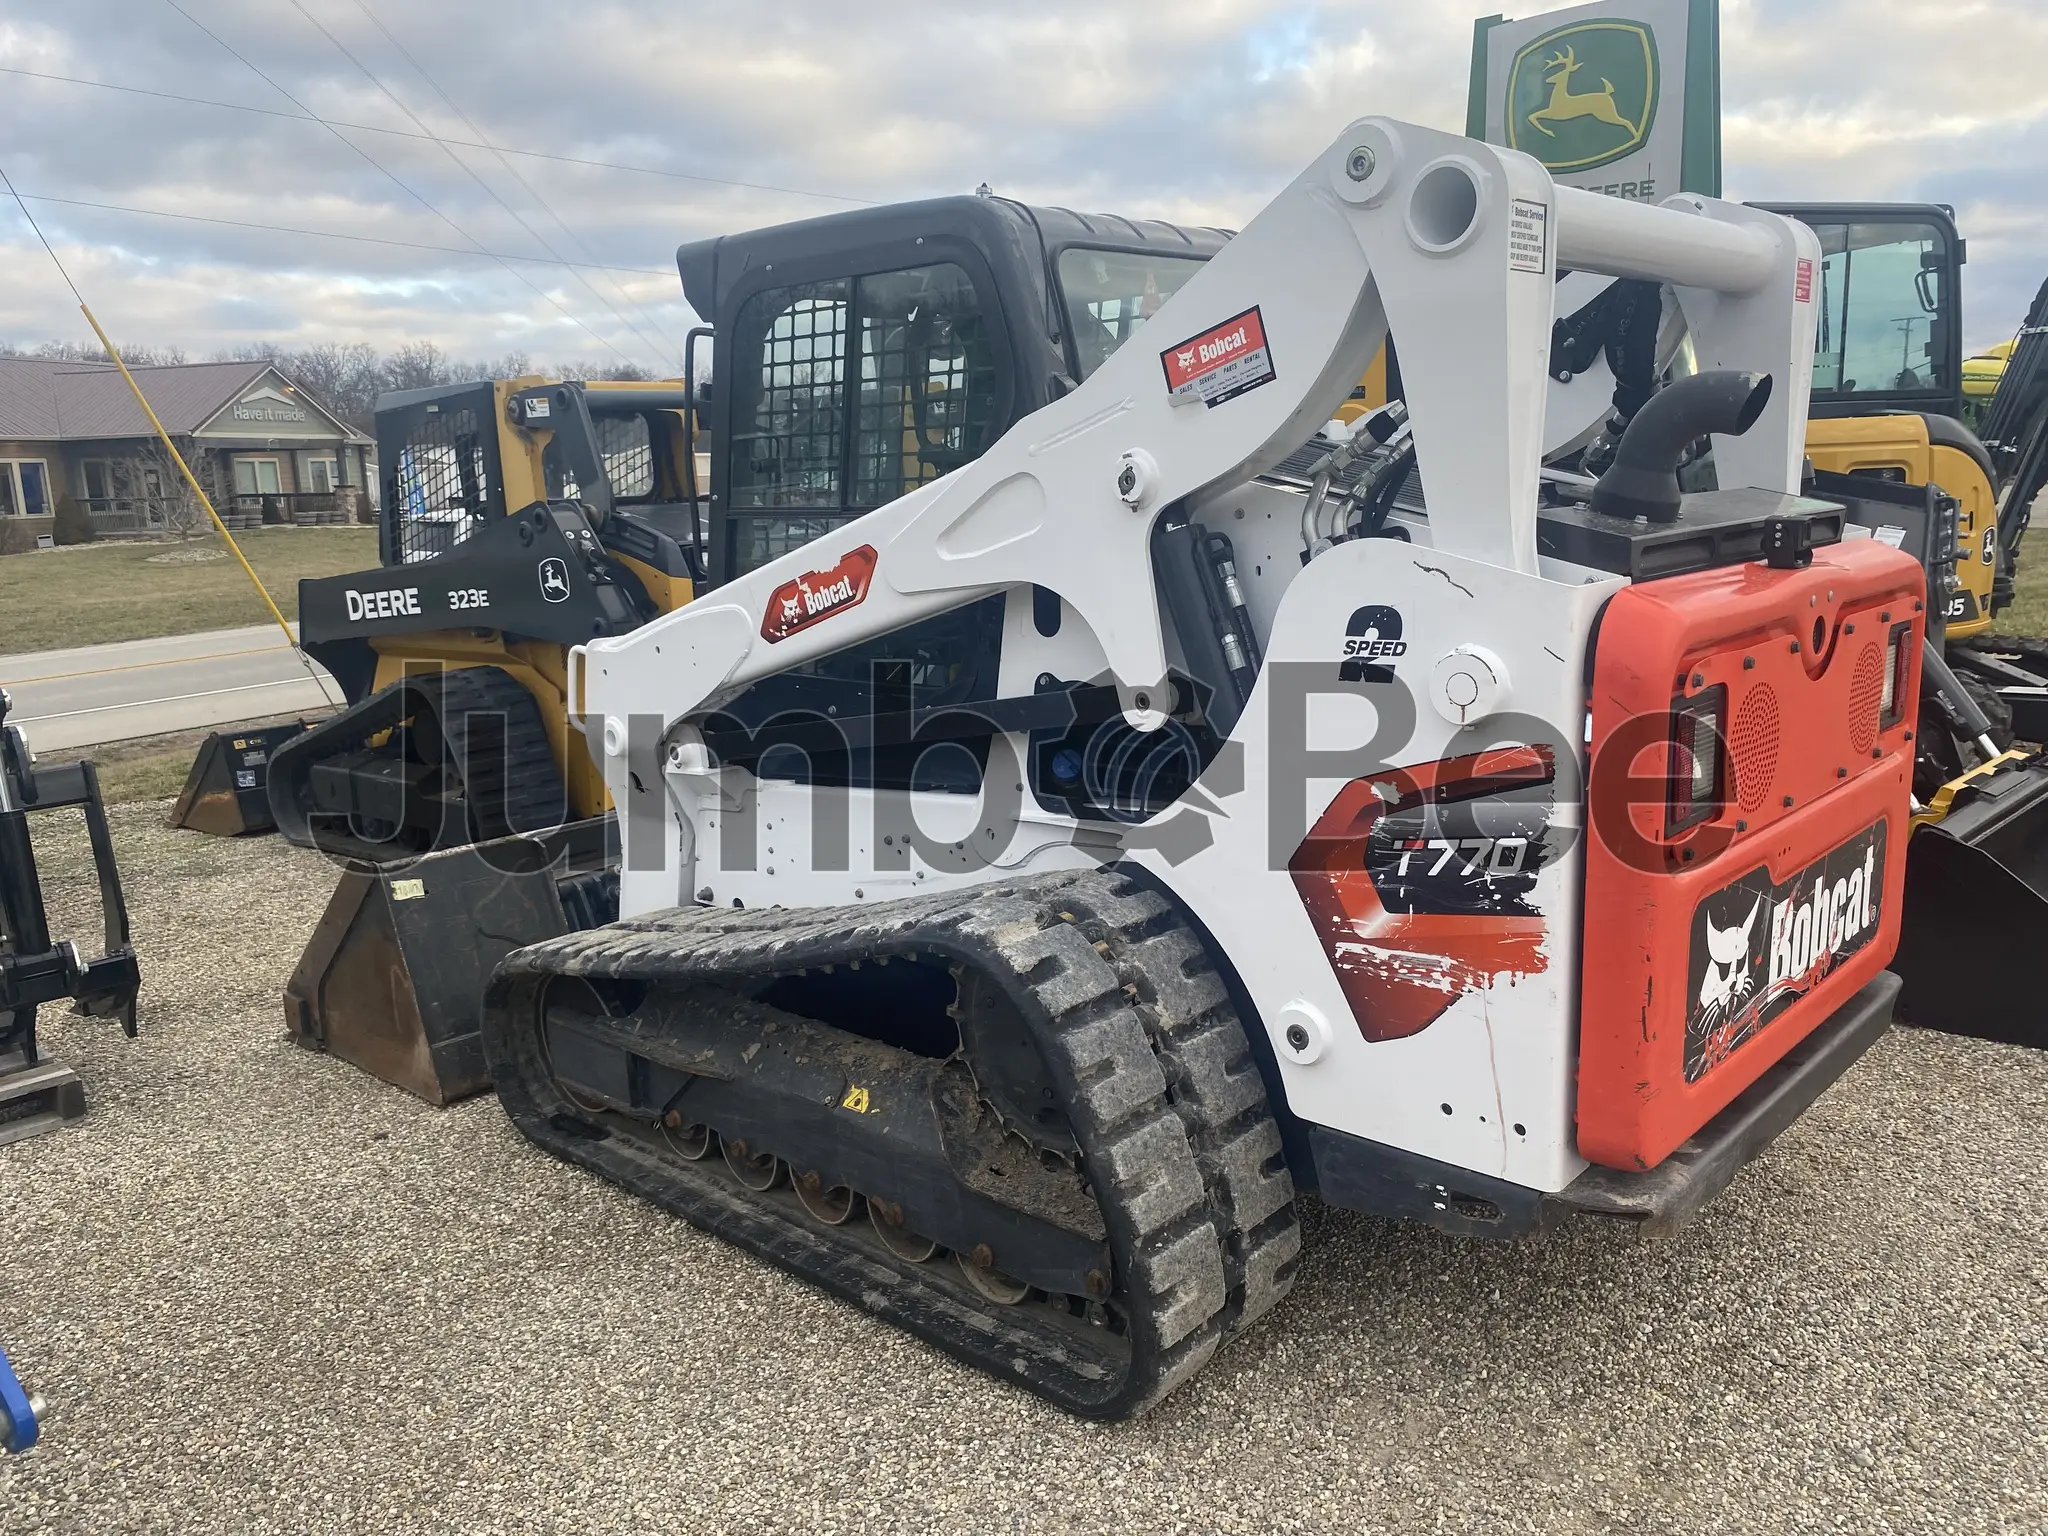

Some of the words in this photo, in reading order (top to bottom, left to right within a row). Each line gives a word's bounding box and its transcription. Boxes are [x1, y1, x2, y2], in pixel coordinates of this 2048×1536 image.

[1569, 179, 1655, 200] ERE
[1514, 206, 1529, 219] Bobcat
[1529, 209, 1544, 221] Service
[1199, 327, 1247, 364] Bobcat
[1179, 383, 1193, 395] SALES
[1199, 372, 1217, 386] SERVICE
[1223, 363, 1238, 374] PARTS
[1244, 352, 1261, 365] RENTAL
[233, 405, 262, 420] Have
[264, 407, 273, 420] it
[275, 408, 305, 422] made
[345, 587, 422, 621] DEERE
[448, 588, 490, 610] 323E
[804, 574, 853, 615] Bobcat
[1343, 640, 1407, 657] SPEED
[1393, 838, 1528, 877] T770
[1767, 844, 1875, 1003] Bobcat
